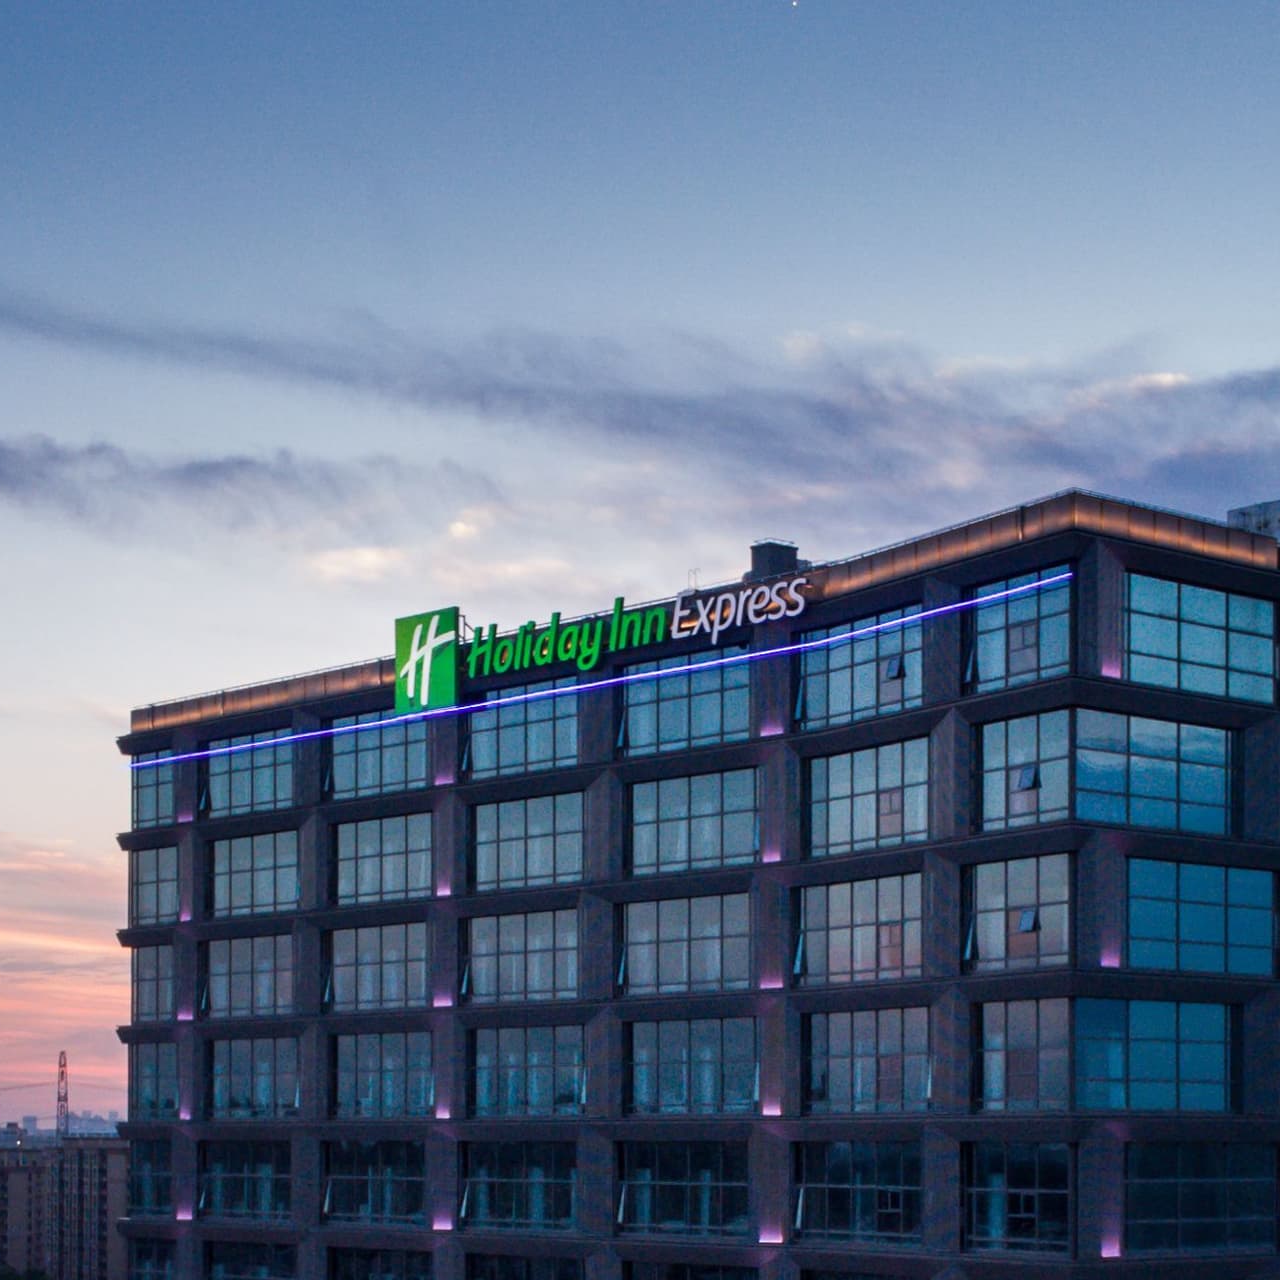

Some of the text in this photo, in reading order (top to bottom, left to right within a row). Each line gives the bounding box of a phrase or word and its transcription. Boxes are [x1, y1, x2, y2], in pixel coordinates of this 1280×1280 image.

[466, 577, 808, 679] Holiday Inn Express
